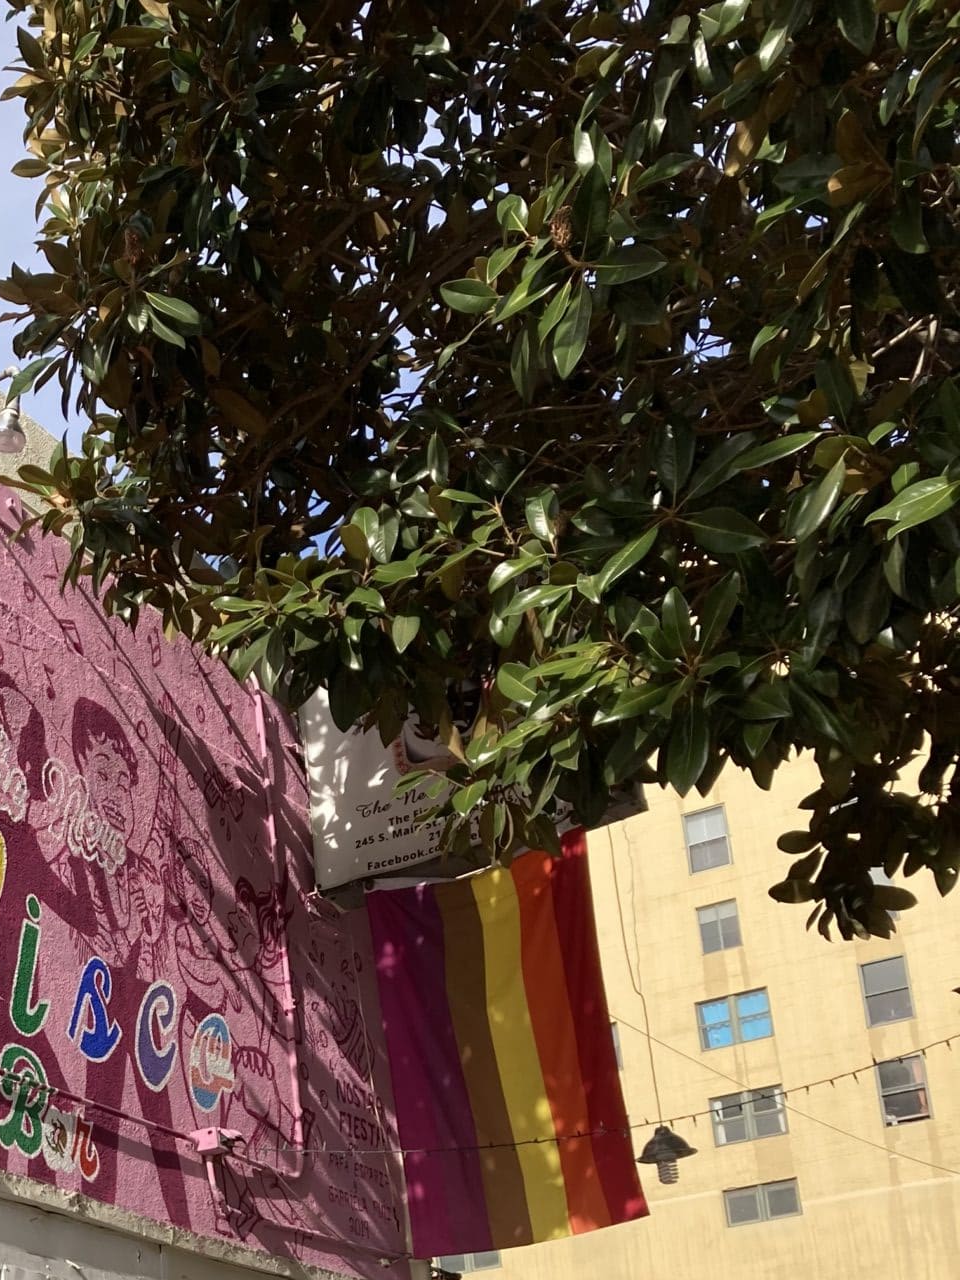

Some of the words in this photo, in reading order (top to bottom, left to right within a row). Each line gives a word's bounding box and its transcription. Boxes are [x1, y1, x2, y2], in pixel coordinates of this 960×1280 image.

[41, 758, 128, 875] New
[355, 800, 391, 818] The
[388, 813, 410, 826] The
[355, 835, 375, 849] 245
[378, 832, 389, 842] S.
